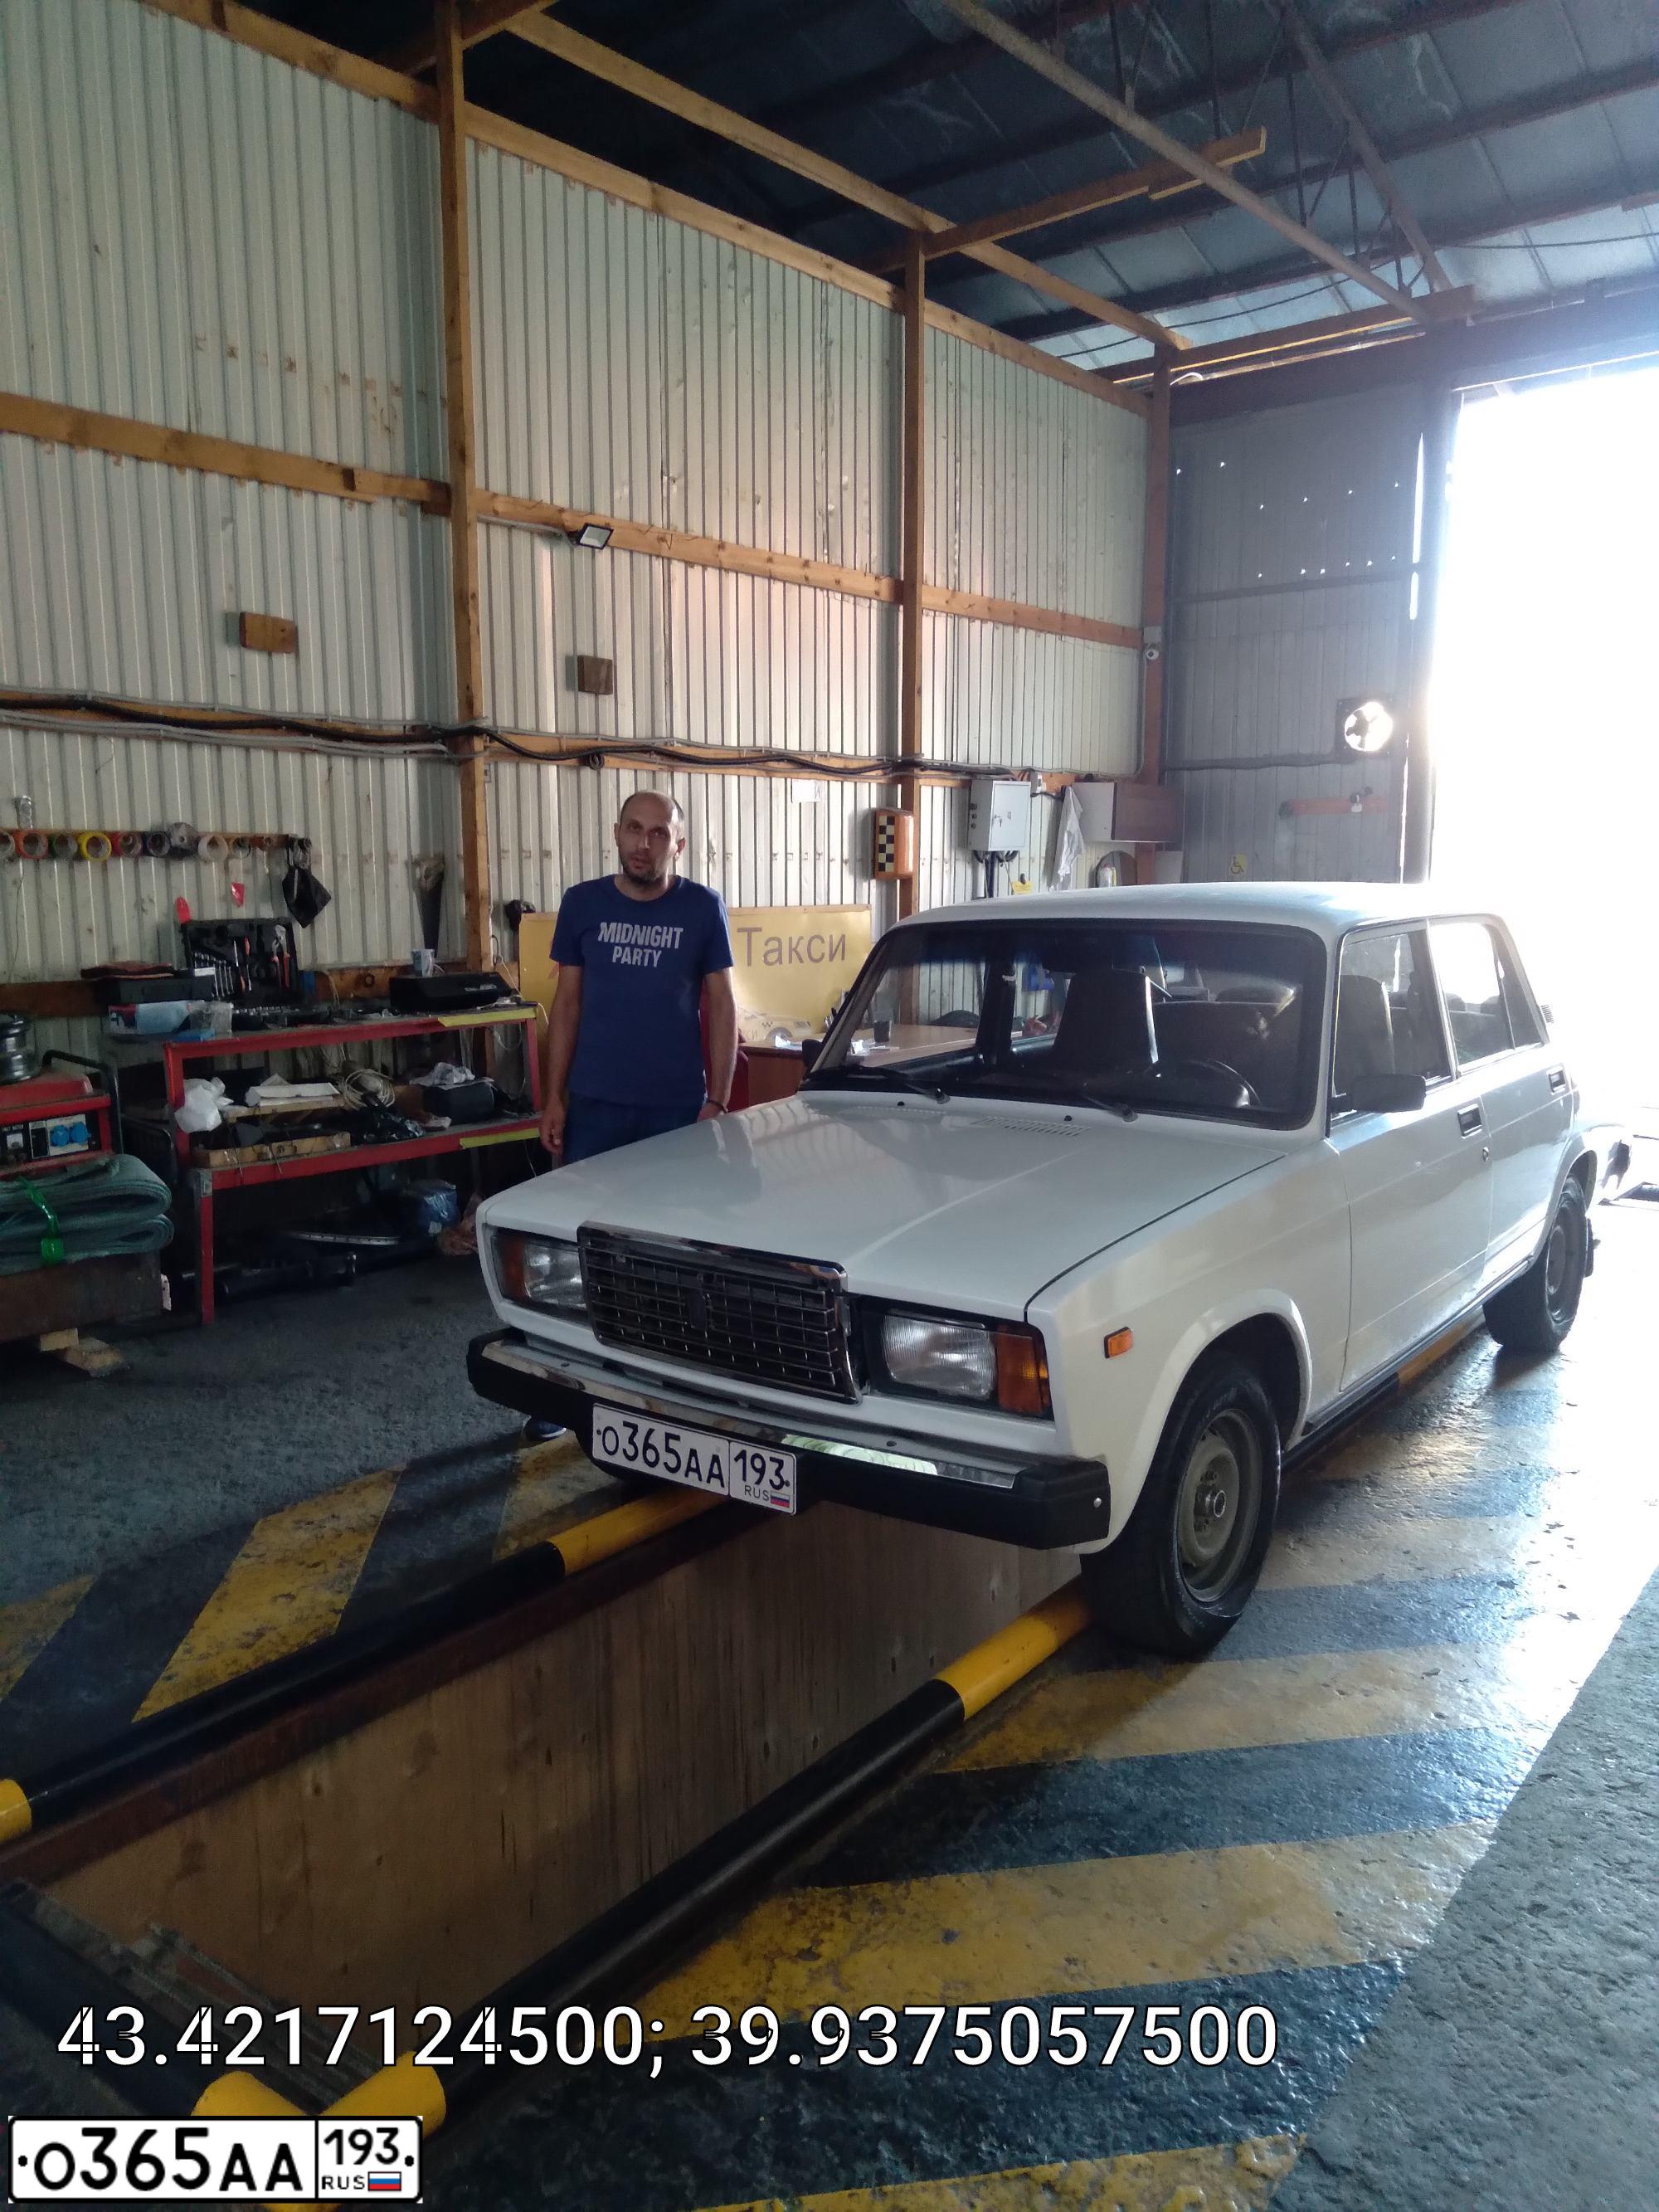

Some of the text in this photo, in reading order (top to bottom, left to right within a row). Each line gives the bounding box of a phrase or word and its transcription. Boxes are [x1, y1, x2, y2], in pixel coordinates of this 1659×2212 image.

[597, 922, 684, 949] MIDNIGHT
[737, 927, 846, 967] Такси
[612, 946, 662, 967] PARTY
[733, 1449, 786, 1491] 193
[744, 1484, 770, 1502] RUS
